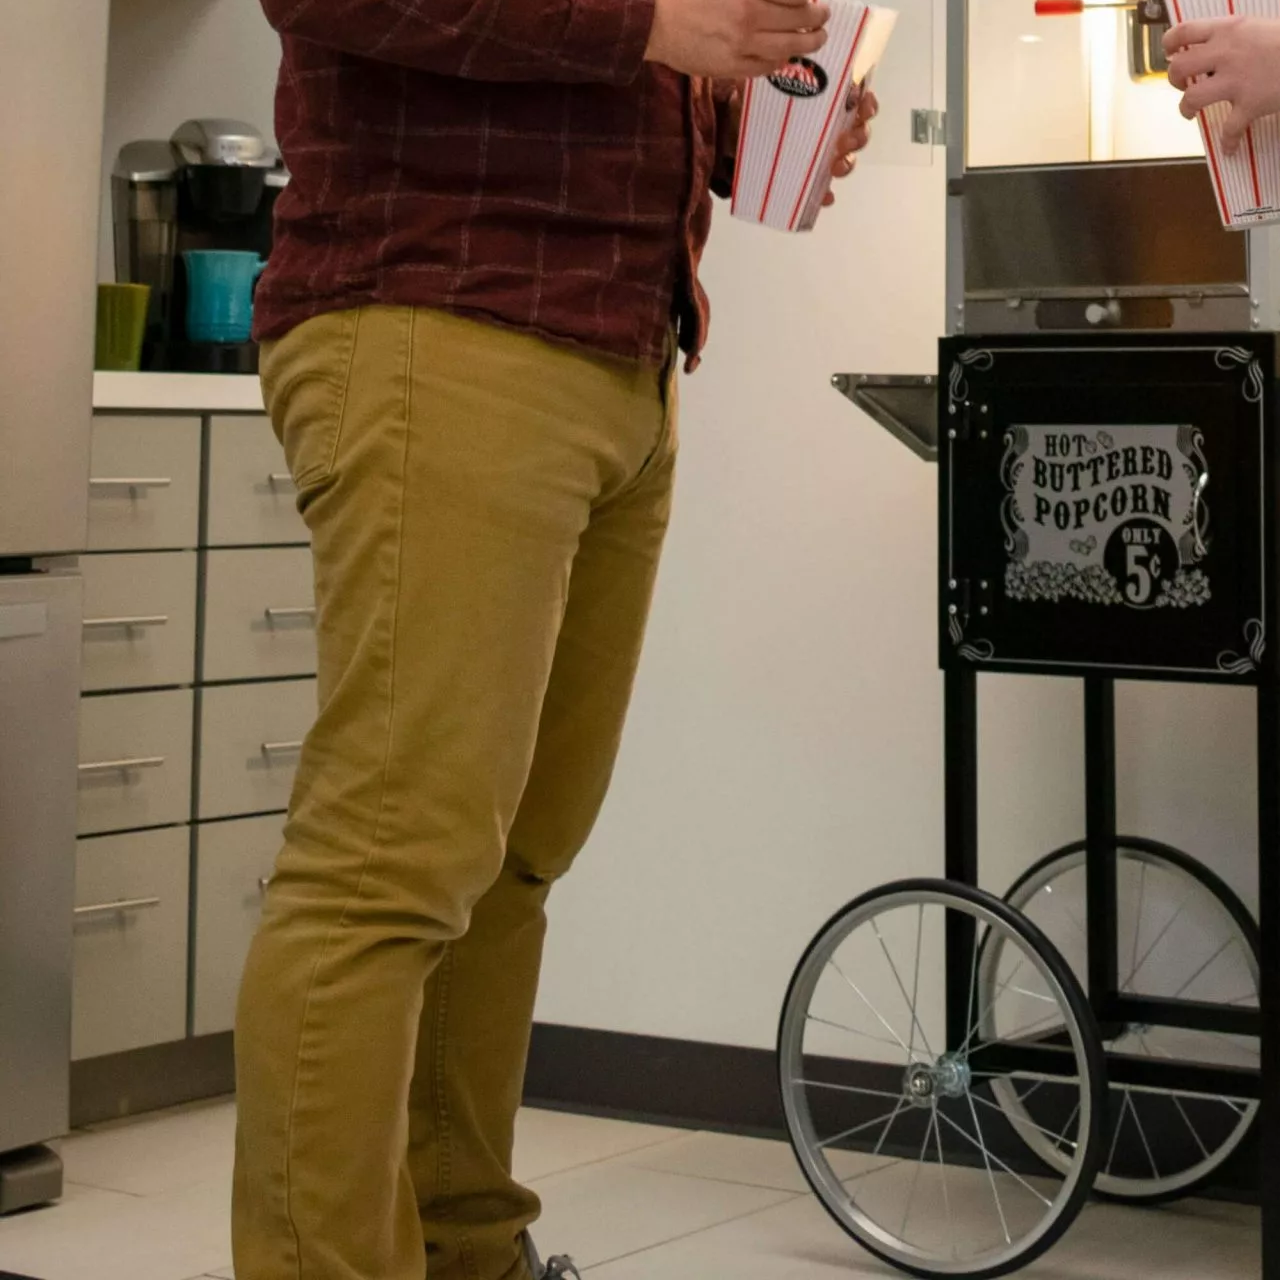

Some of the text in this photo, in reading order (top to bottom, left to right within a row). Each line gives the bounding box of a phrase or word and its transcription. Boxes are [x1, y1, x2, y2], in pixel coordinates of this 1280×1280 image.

[1045, 434, 1087, 457] HOT
[1033, 446, 1172, 492] BUTTERED
[1034, 484, 1171, 530] POPCORN
[1122, 527, 1161, 544] ONLY
